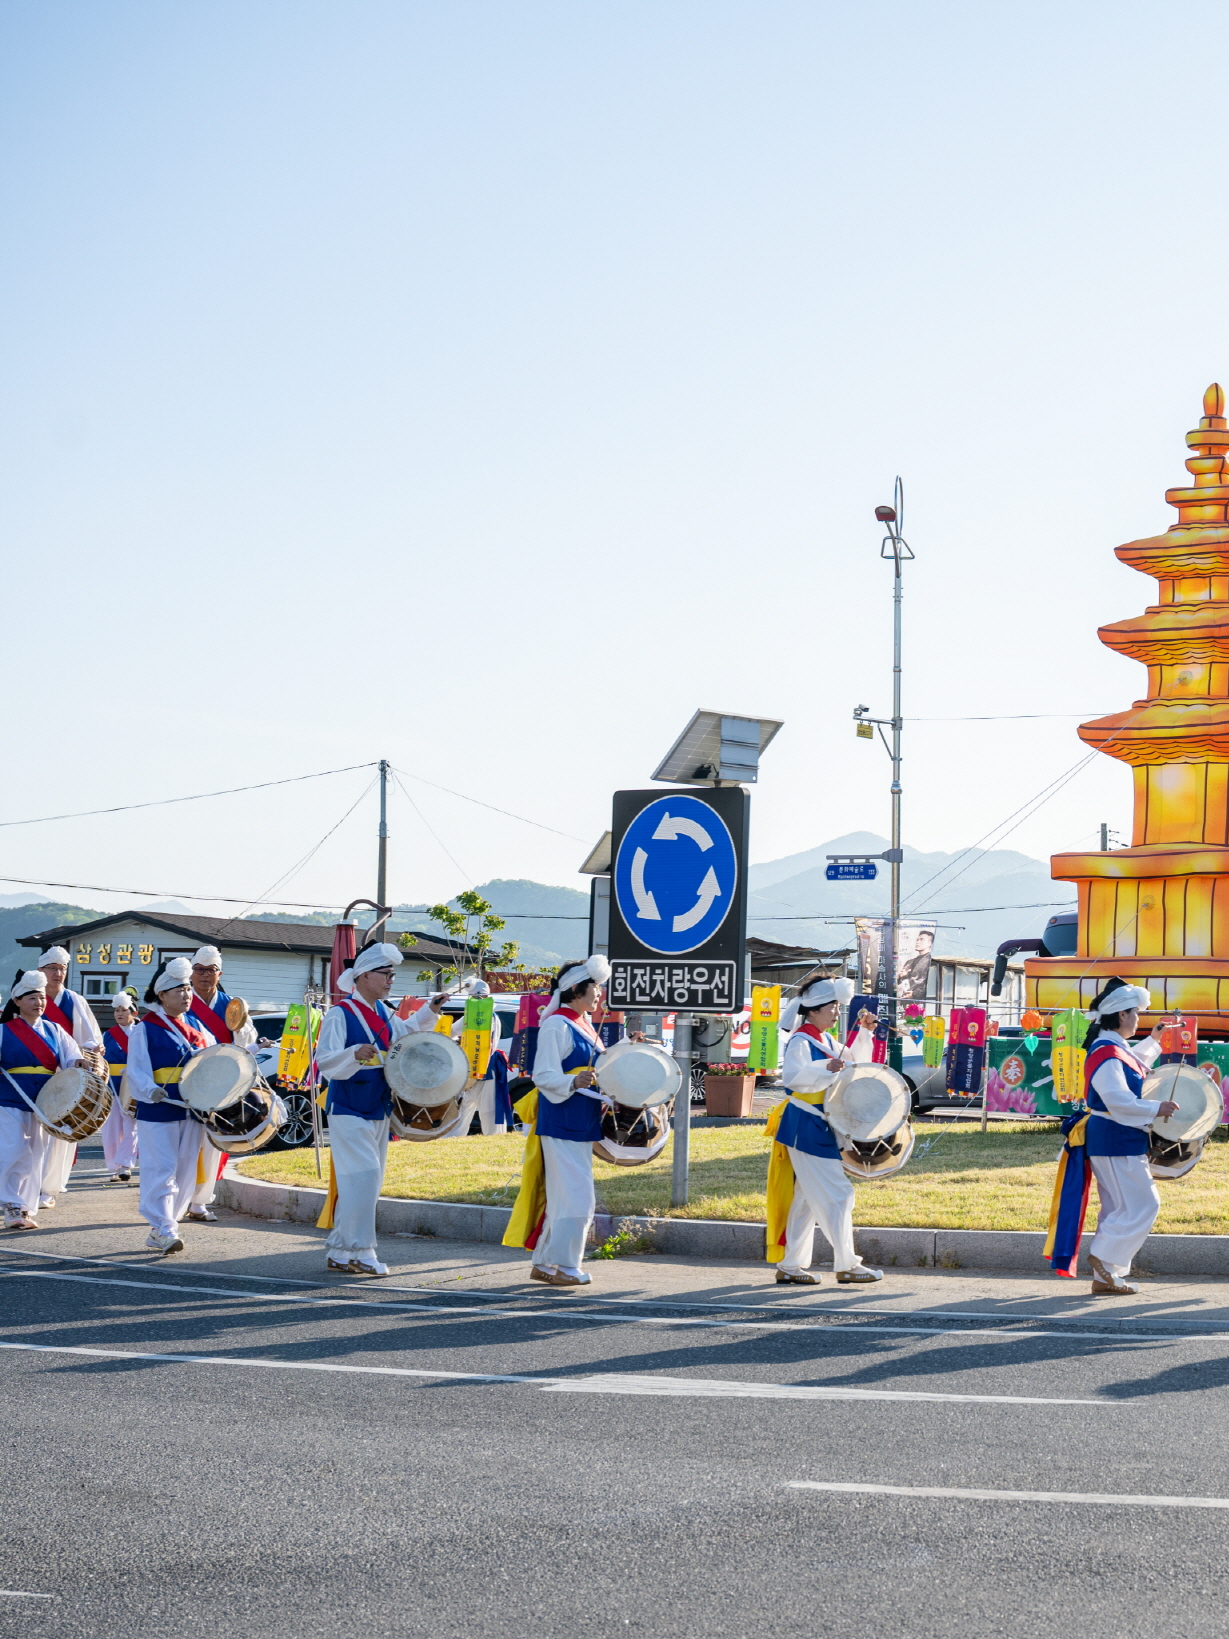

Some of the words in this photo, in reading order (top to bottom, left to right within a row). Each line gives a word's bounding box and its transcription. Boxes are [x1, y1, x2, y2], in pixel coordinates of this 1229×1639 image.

[76, 943, 155, 965] 삼성관광
[612, 965, 729, 1004] 회전차량우선
[877, 955, 887, 990] 마술사의
[1003, 1060, 1021, 1083] 奉
